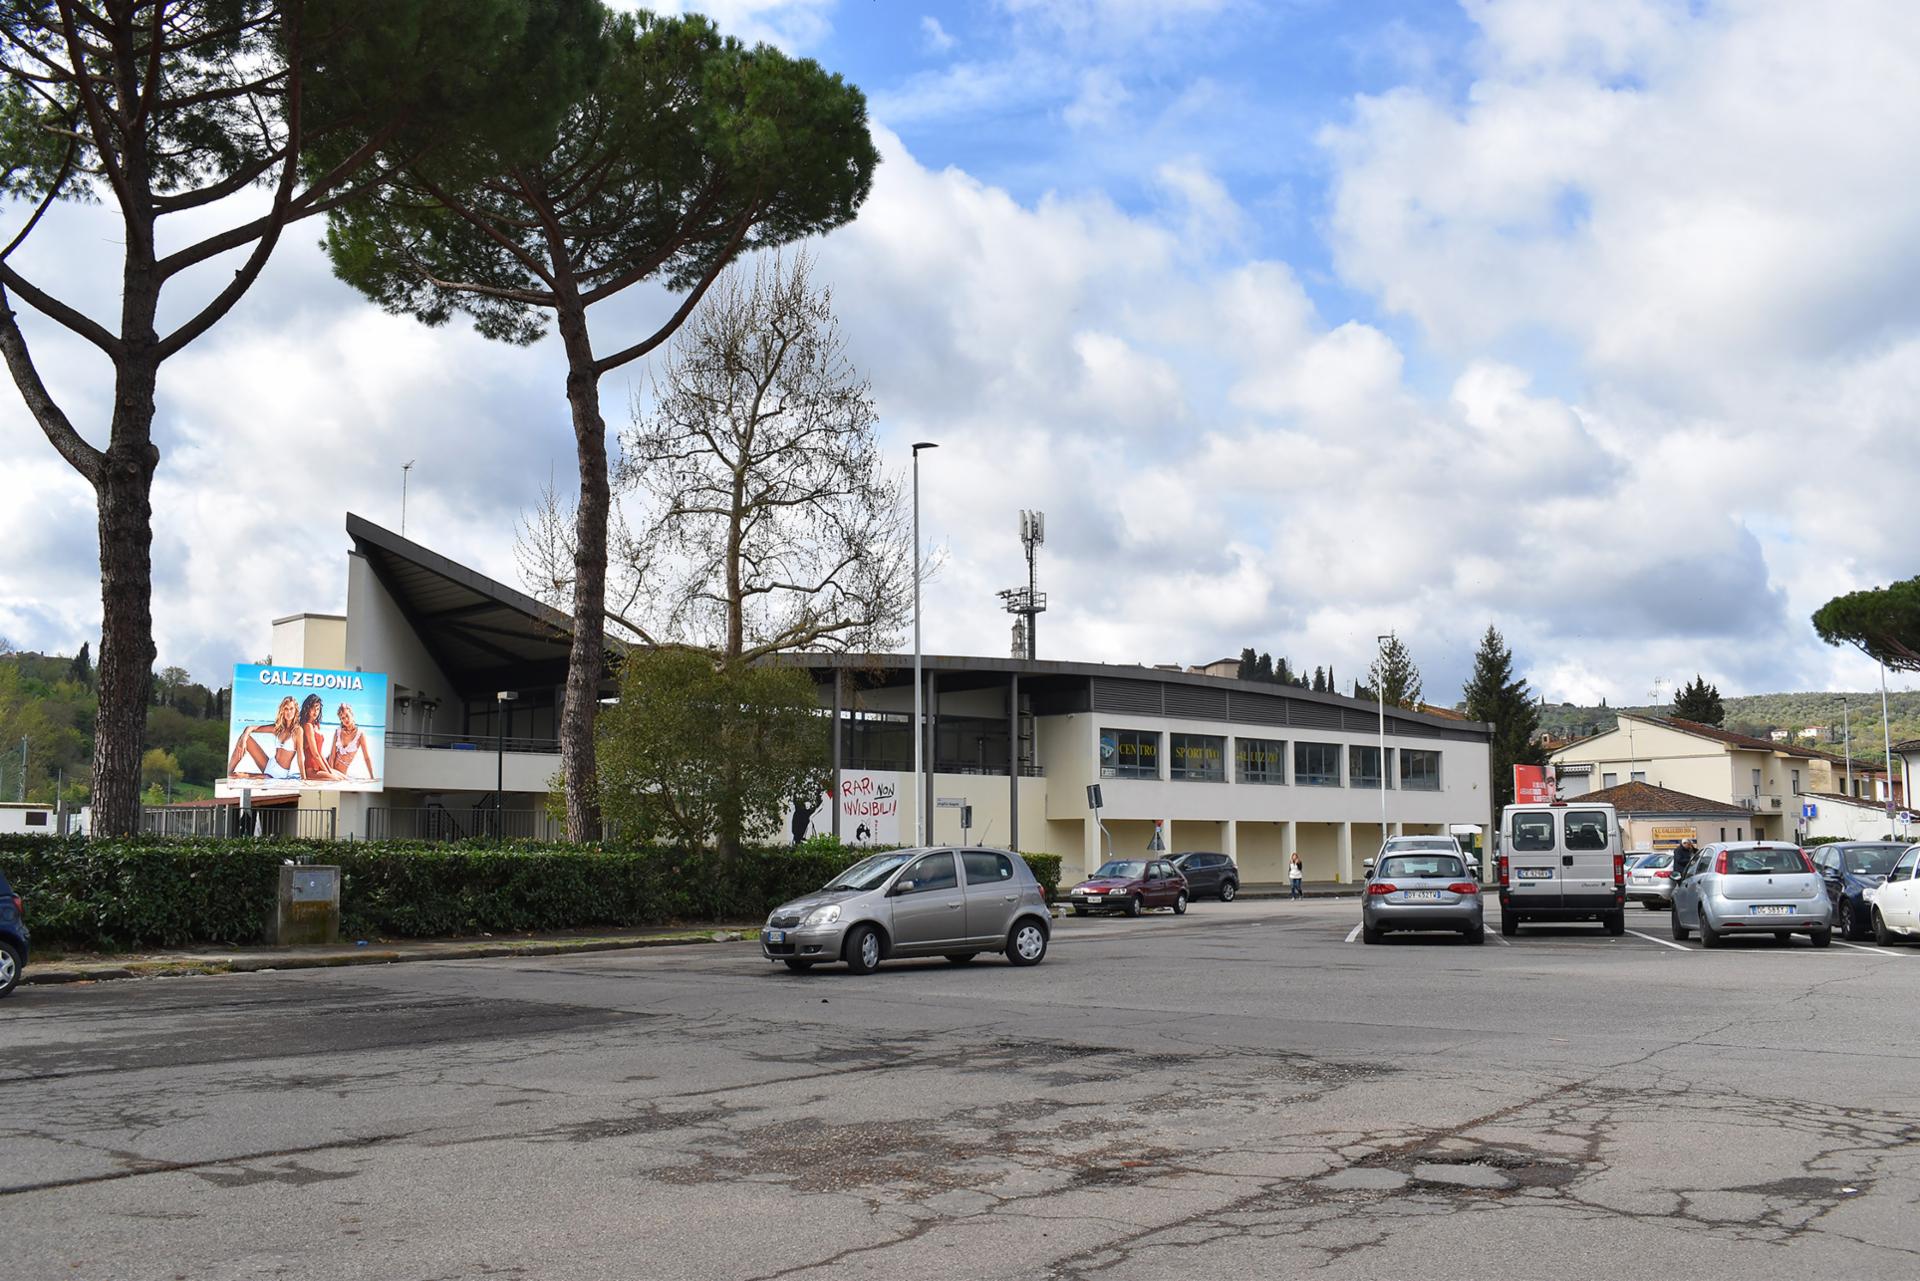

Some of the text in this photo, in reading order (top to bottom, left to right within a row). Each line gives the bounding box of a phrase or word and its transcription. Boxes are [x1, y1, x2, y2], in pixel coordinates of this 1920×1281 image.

[259, 670, 363, 690] CALZEDONIA
[1120, 743, 1157, 756] CENTRO
[841, 777, 895, 797] RARI NON
[843, 799, 897, 816] INVISIBILI!
